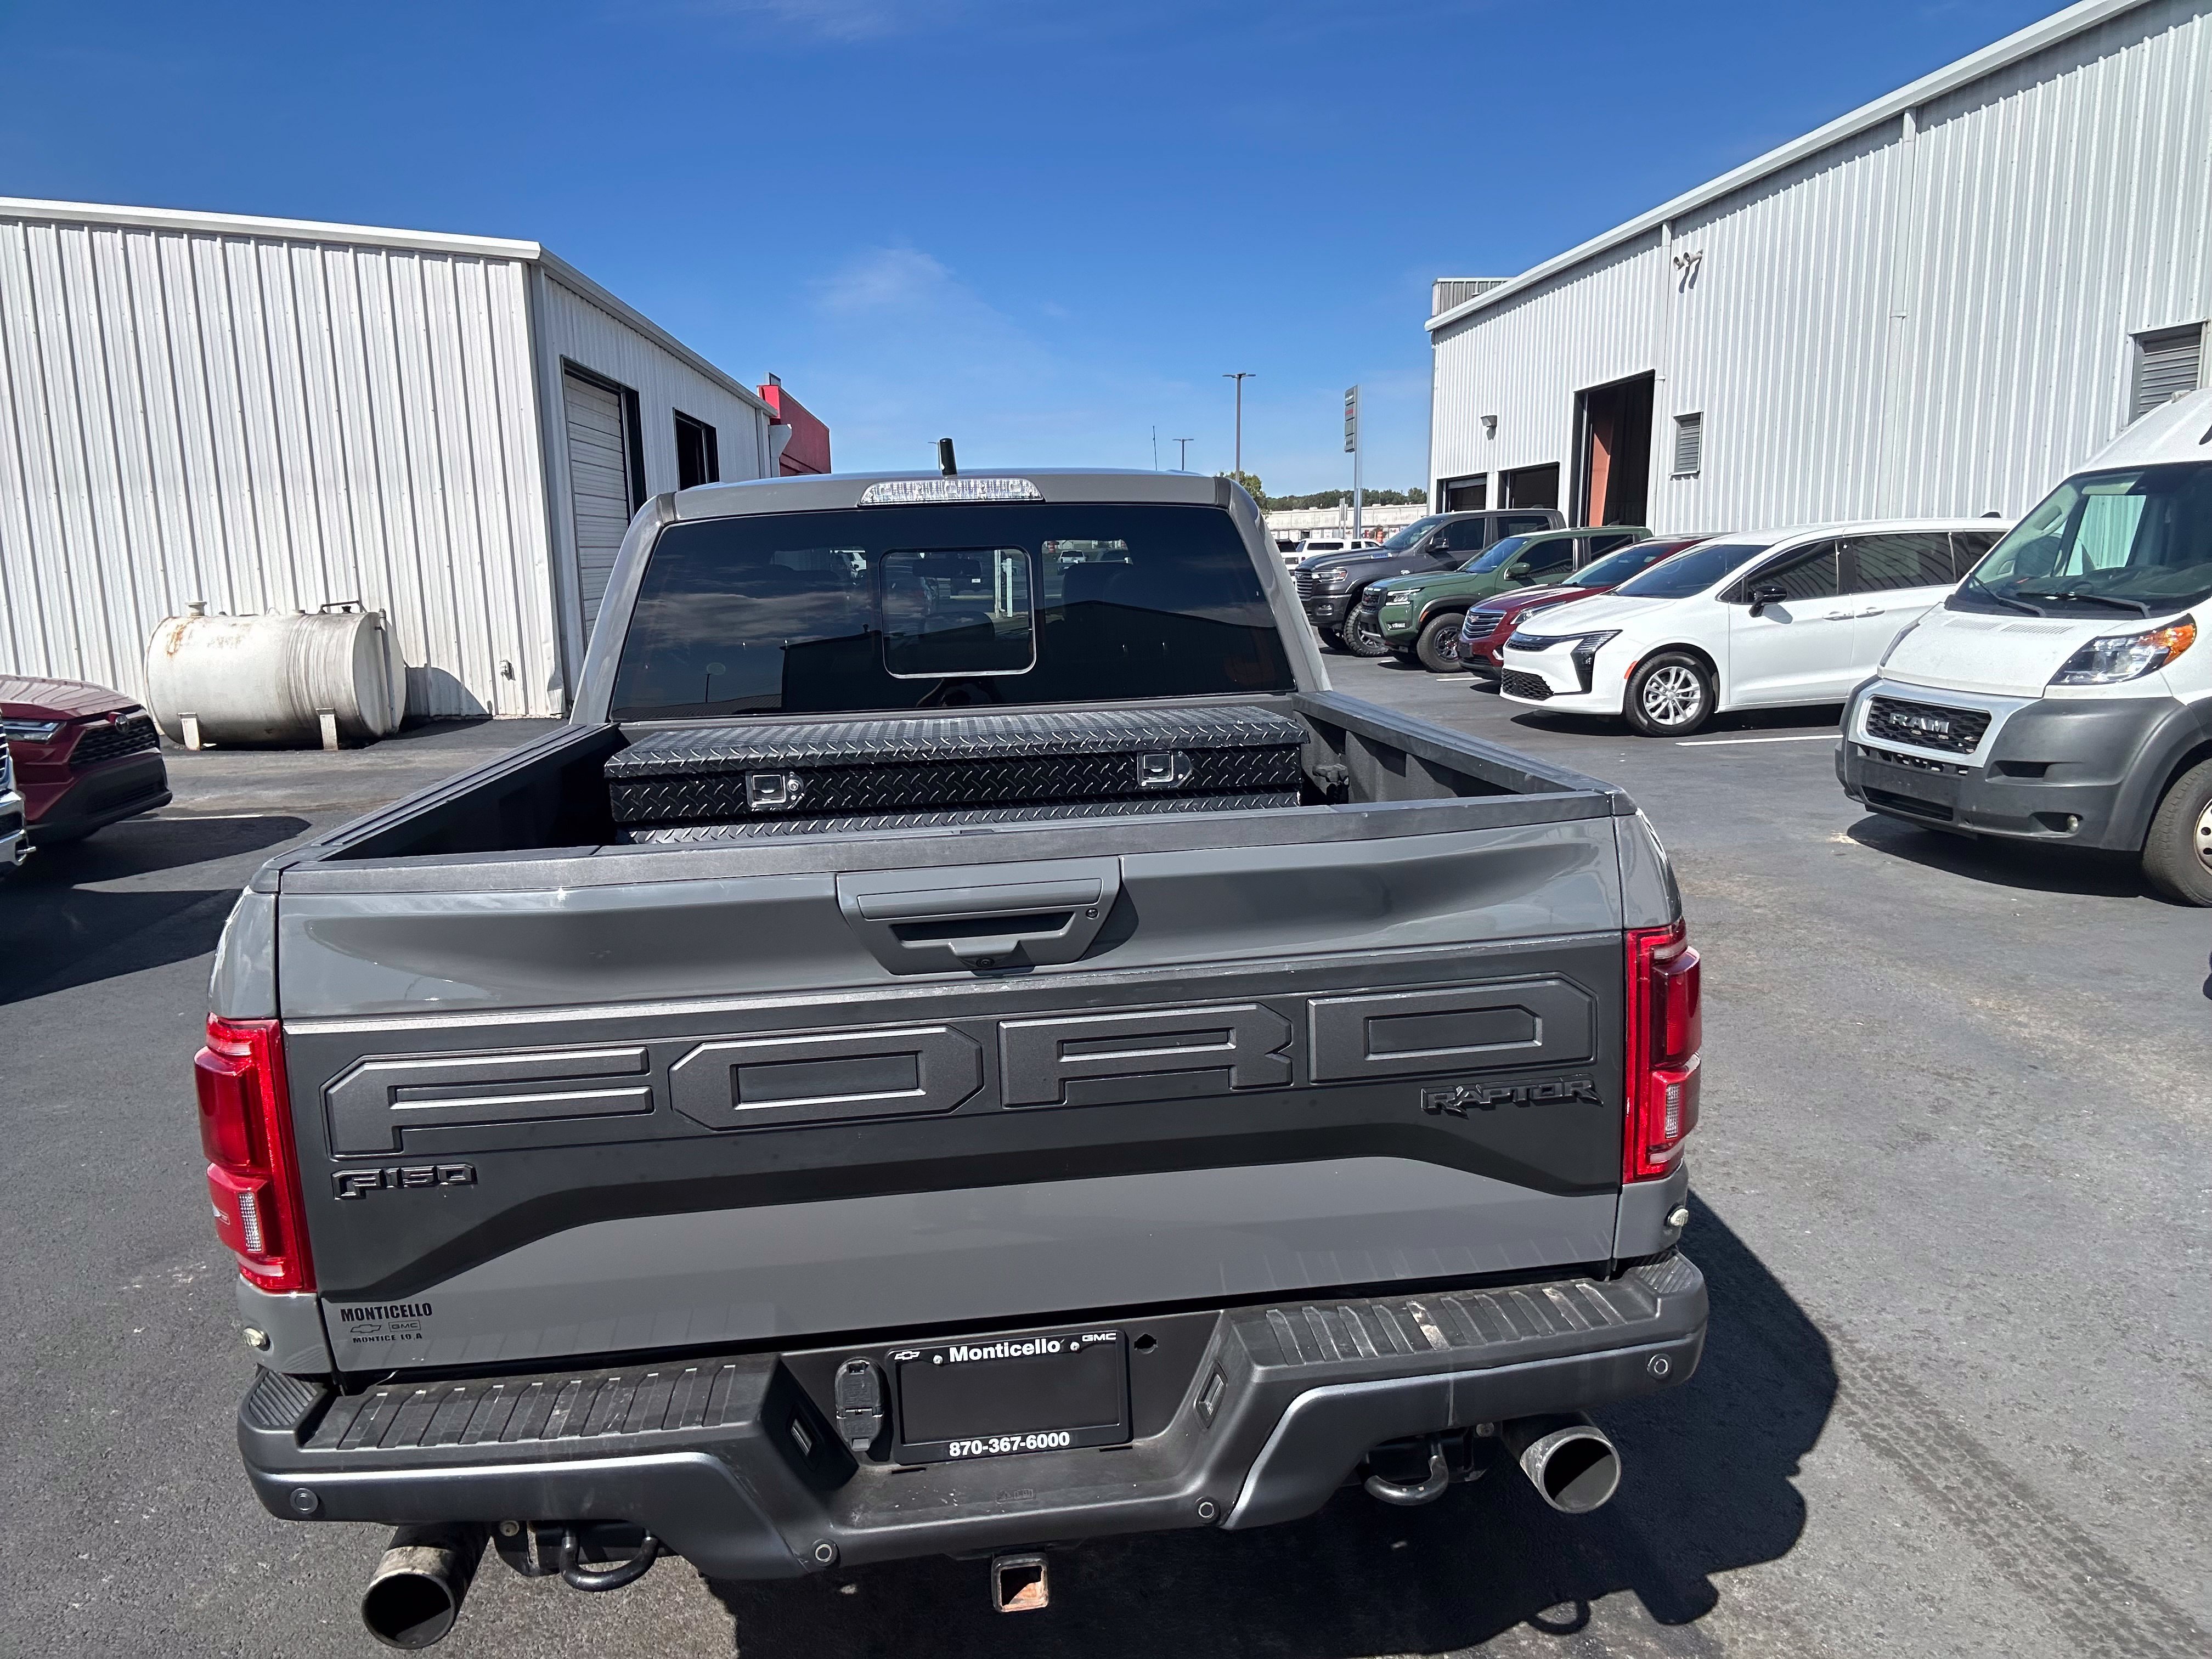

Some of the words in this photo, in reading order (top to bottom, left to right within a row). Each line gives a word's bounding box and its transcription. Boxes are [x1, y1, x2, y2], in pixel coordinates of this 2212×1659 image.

[1889, 713, 1950, 733] RAM
[320, 973, 1597, 1161] FORD
[1421, 1074, 1604, 1119] RAPTOR
[340, 1302, 432, 1322] MONTICELLO
[1082, 1333, 1116, 1342] GMC
[949, 1339, 1060, 1363] Monticello
[949, 1431, 1070, 1457] 870-367-6000
